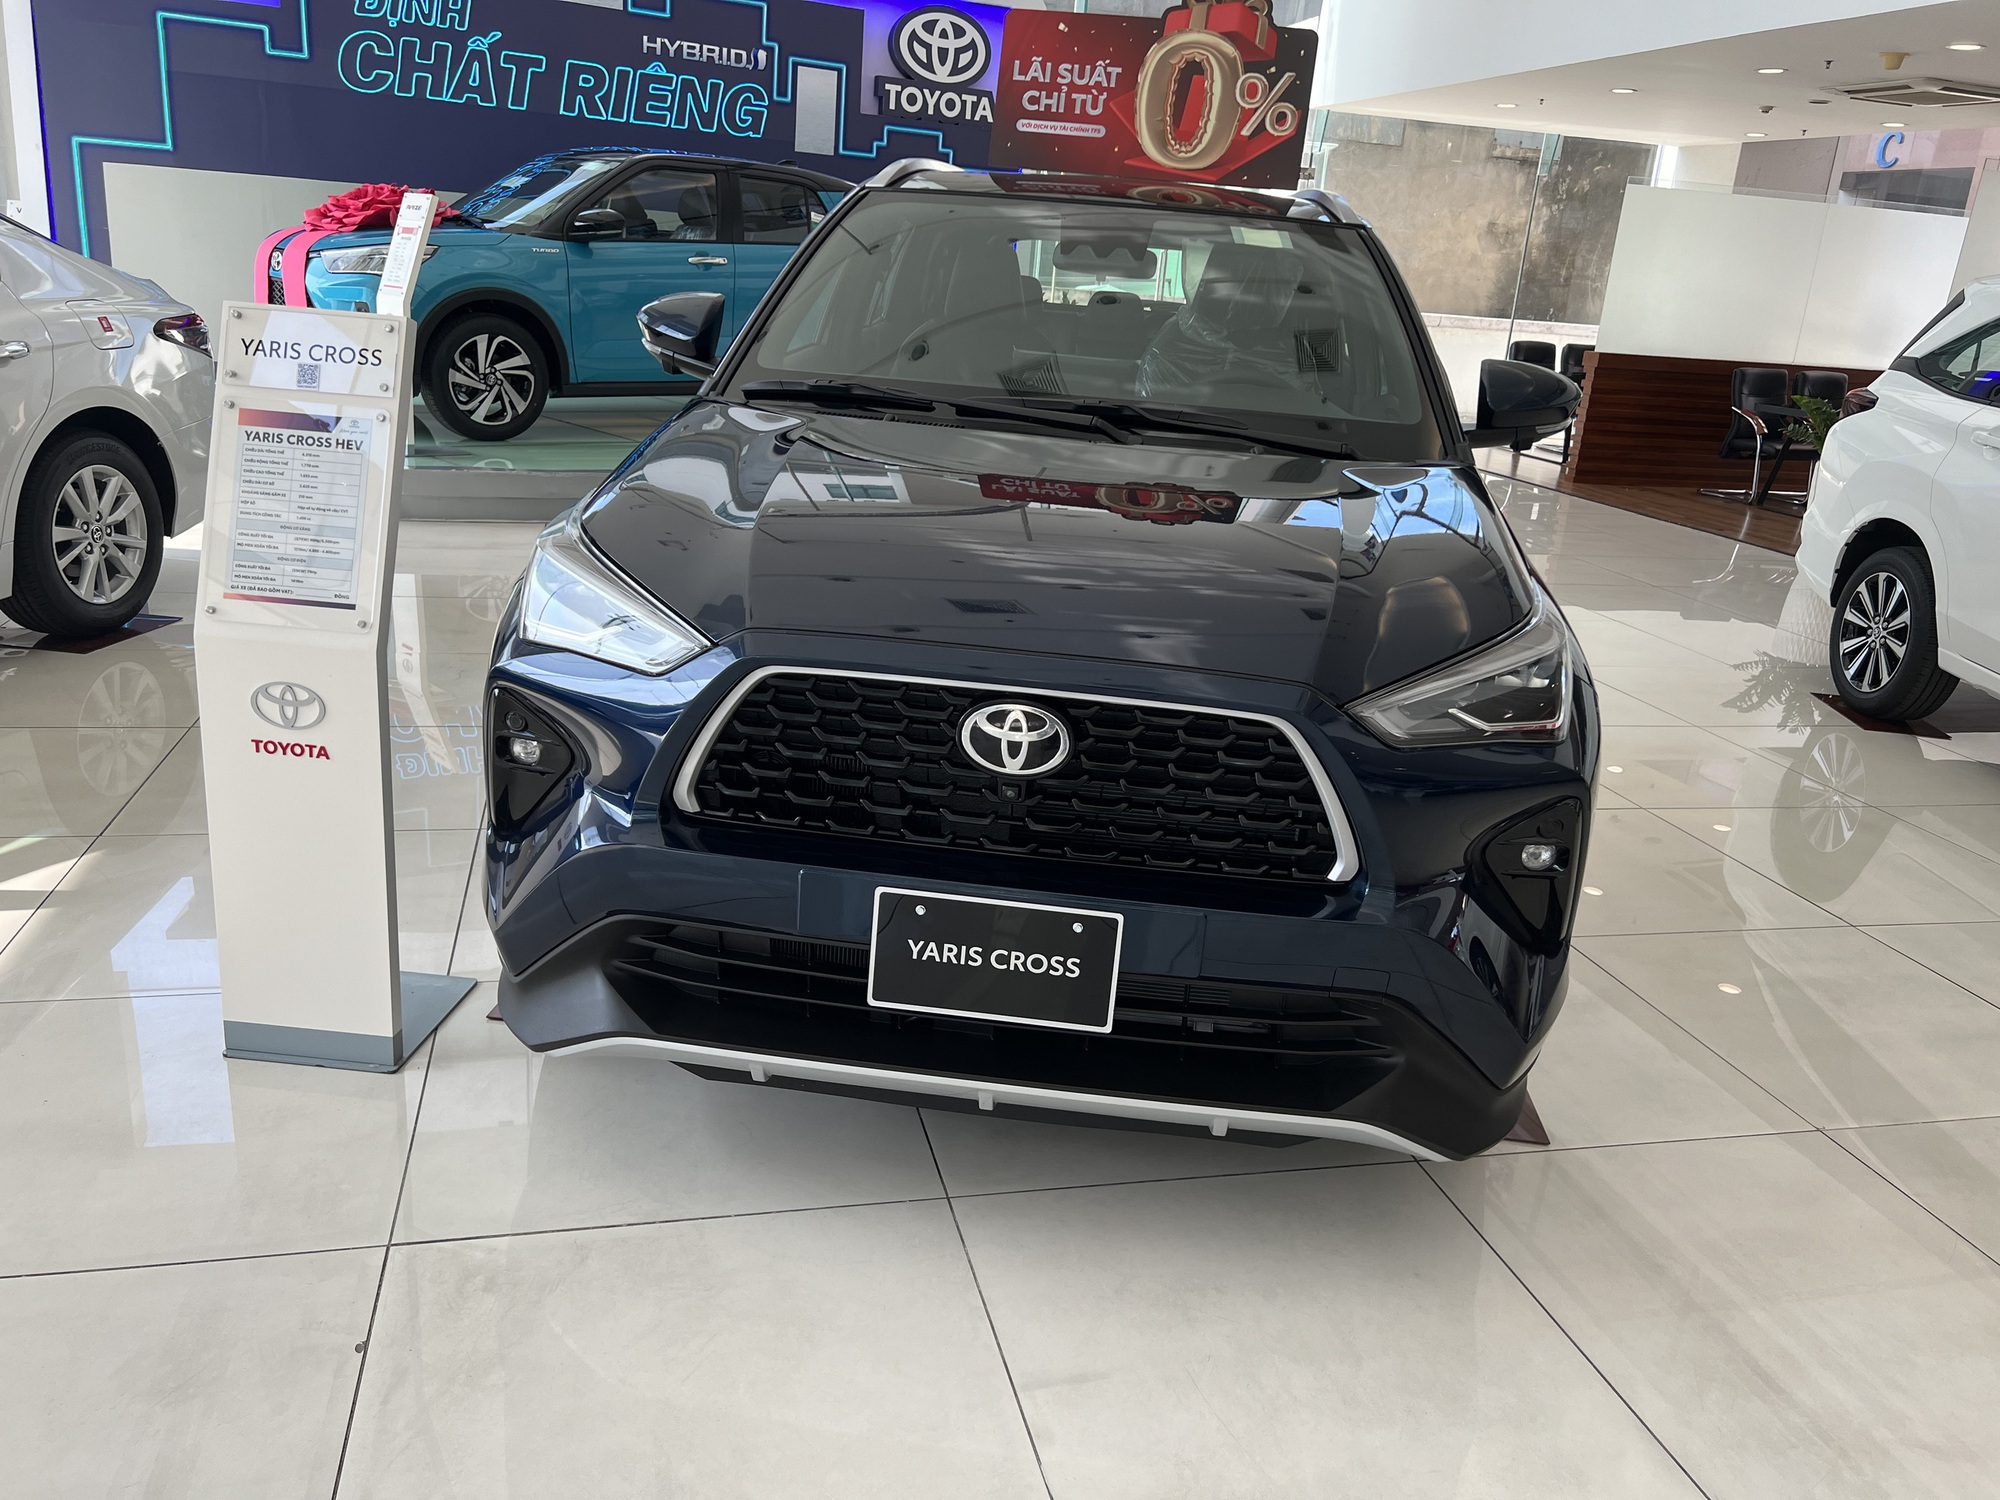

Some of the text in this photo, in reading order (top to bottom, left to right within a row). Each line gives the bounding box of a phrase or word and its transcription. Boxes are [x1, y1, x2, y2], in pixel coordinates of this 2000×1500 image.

[338, 30, 769, 138] CHẤT RIÊNG
[1012, 56, 1122, 88] LÃI SUẤT
[884, 83, 994, 123] TOYOTA
[1022, 86, 1107, 116] CHỈ TỪ
[1033, 123, 1049, 131] DỊCH
[1069, 125, 1090, 133] CHÍNH
[1875, 132, 1904, 168] C
[240, 338, 382, 367] YARIS CROSS
[245, 430, 364, 451] YARIS CROSS HEV
[251, 739, 330, 760] TOYOTA
[907, 939, 1081, 978] YARIS CROSS
